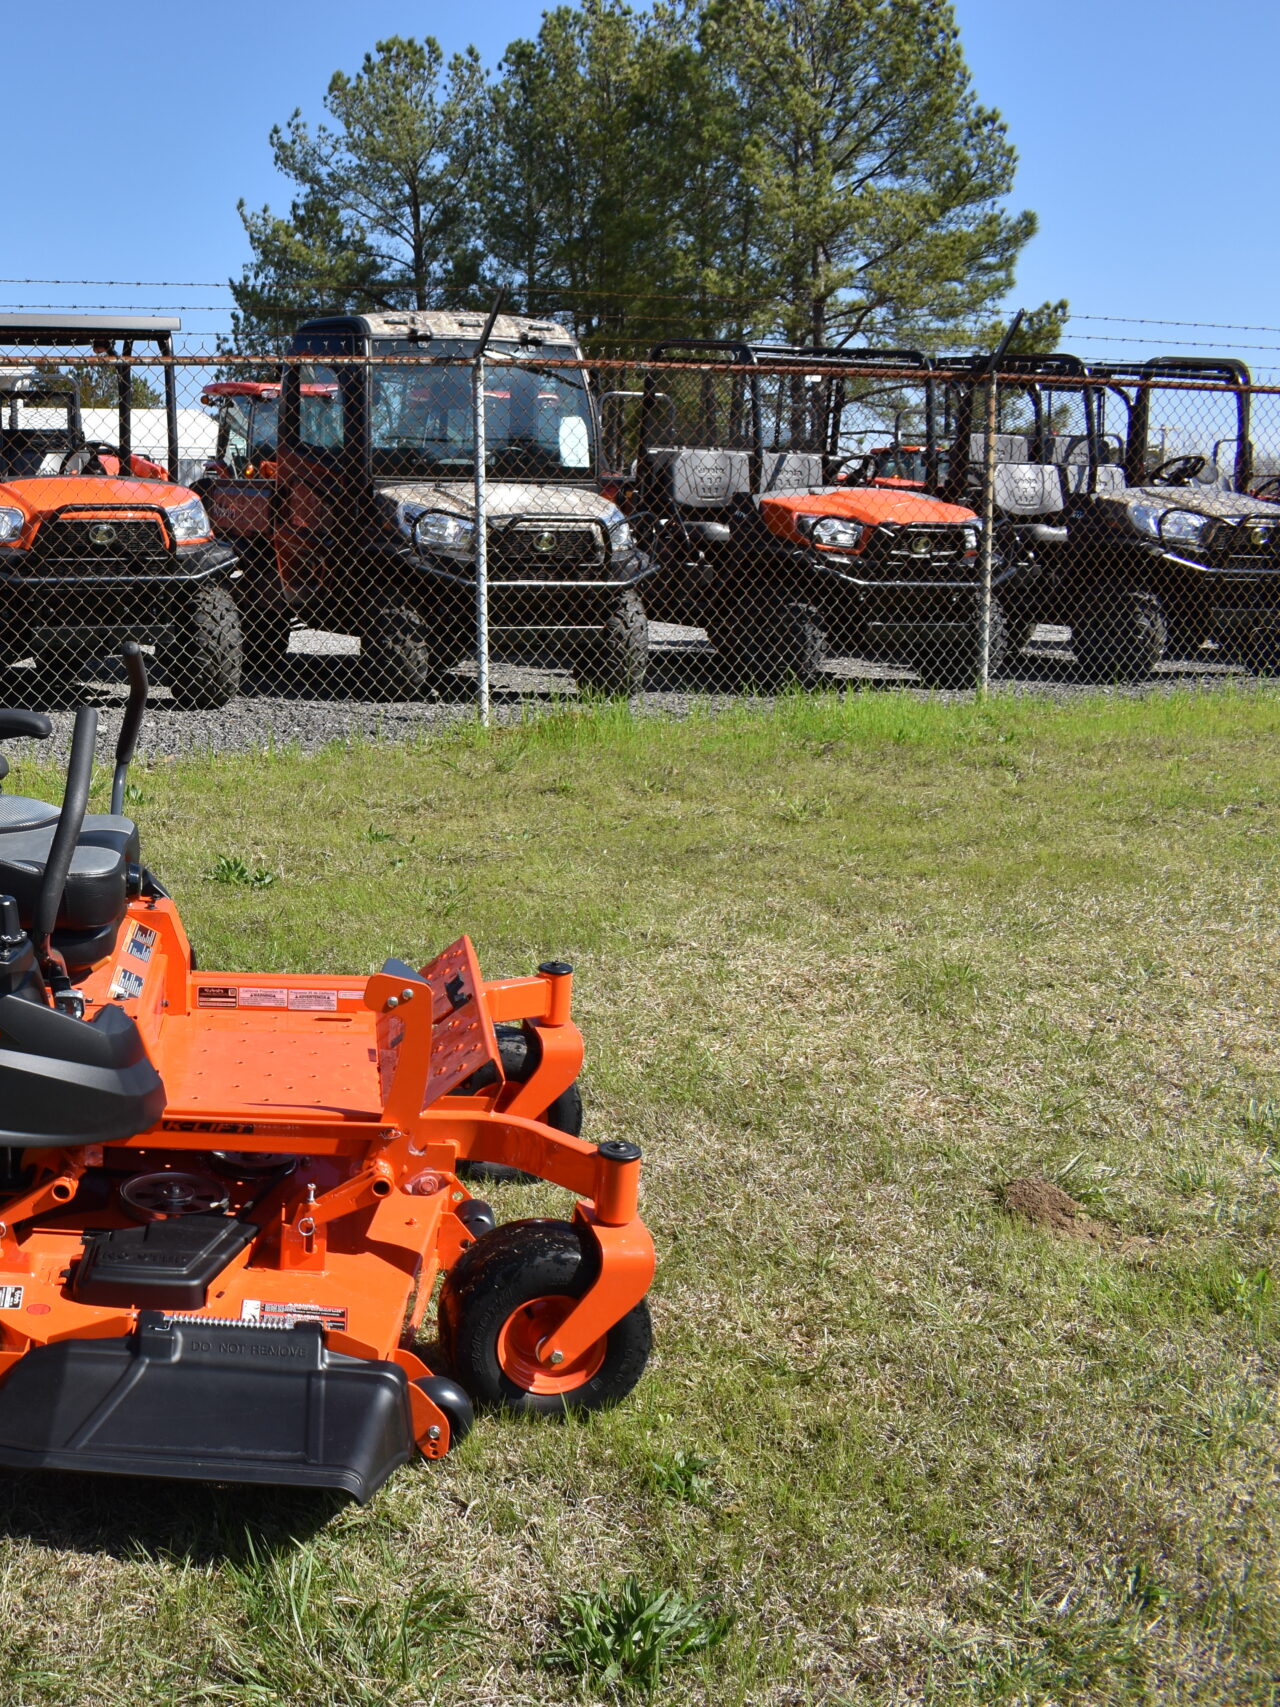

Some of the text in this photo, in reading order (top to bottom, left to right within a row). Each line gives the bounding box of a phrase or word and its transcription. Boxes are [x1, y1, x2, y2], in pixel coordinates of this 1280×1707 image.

[191, 1340, 307, 1358] DO NOT REMOVE
